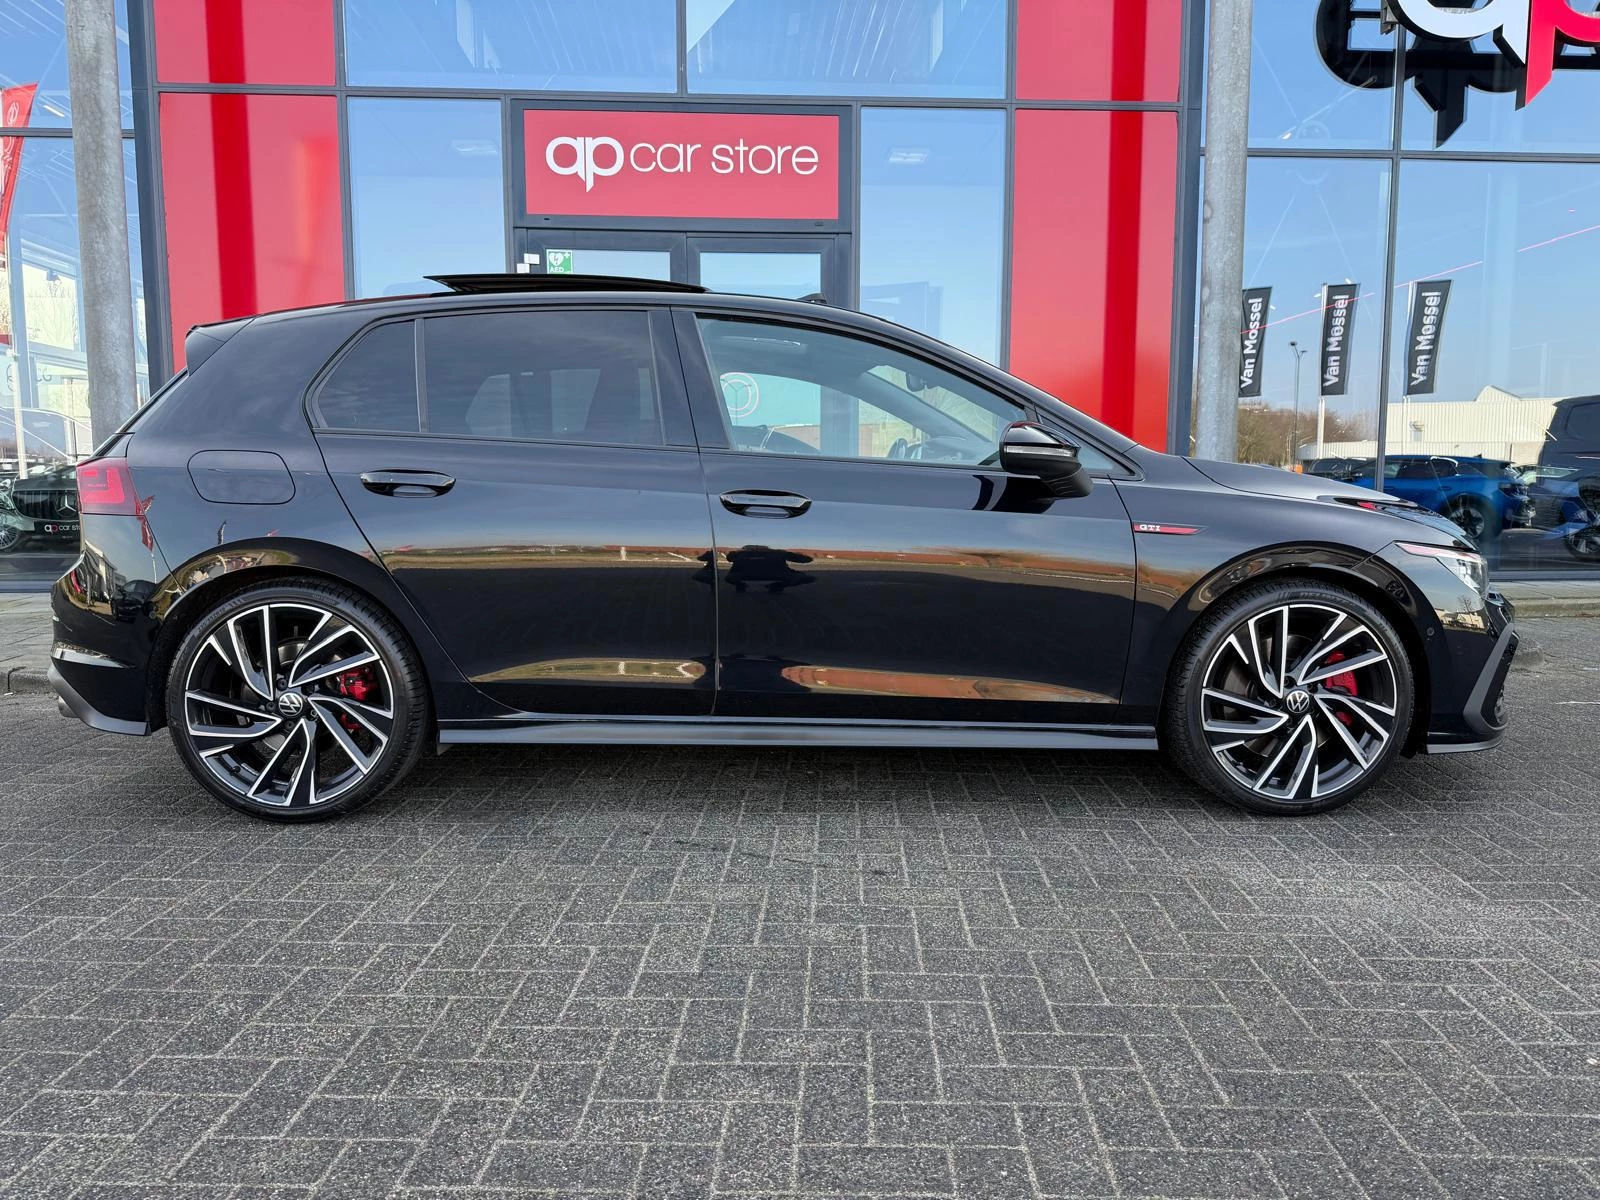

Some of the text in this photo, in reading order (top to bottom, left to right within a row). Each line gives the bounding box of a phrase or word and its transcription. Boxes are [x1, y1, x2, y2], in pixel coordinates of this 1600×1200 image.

[630, 142, 701, 173] car
[711, 138, 819, 176] store
[1240, 297, 1263, 389] Van Mossel
[1322, 294, 1349, 387] Van Mossel
[1410, 291, 1441, 386] Van Mossel
[1139, 524, 1161, 532] GTI
